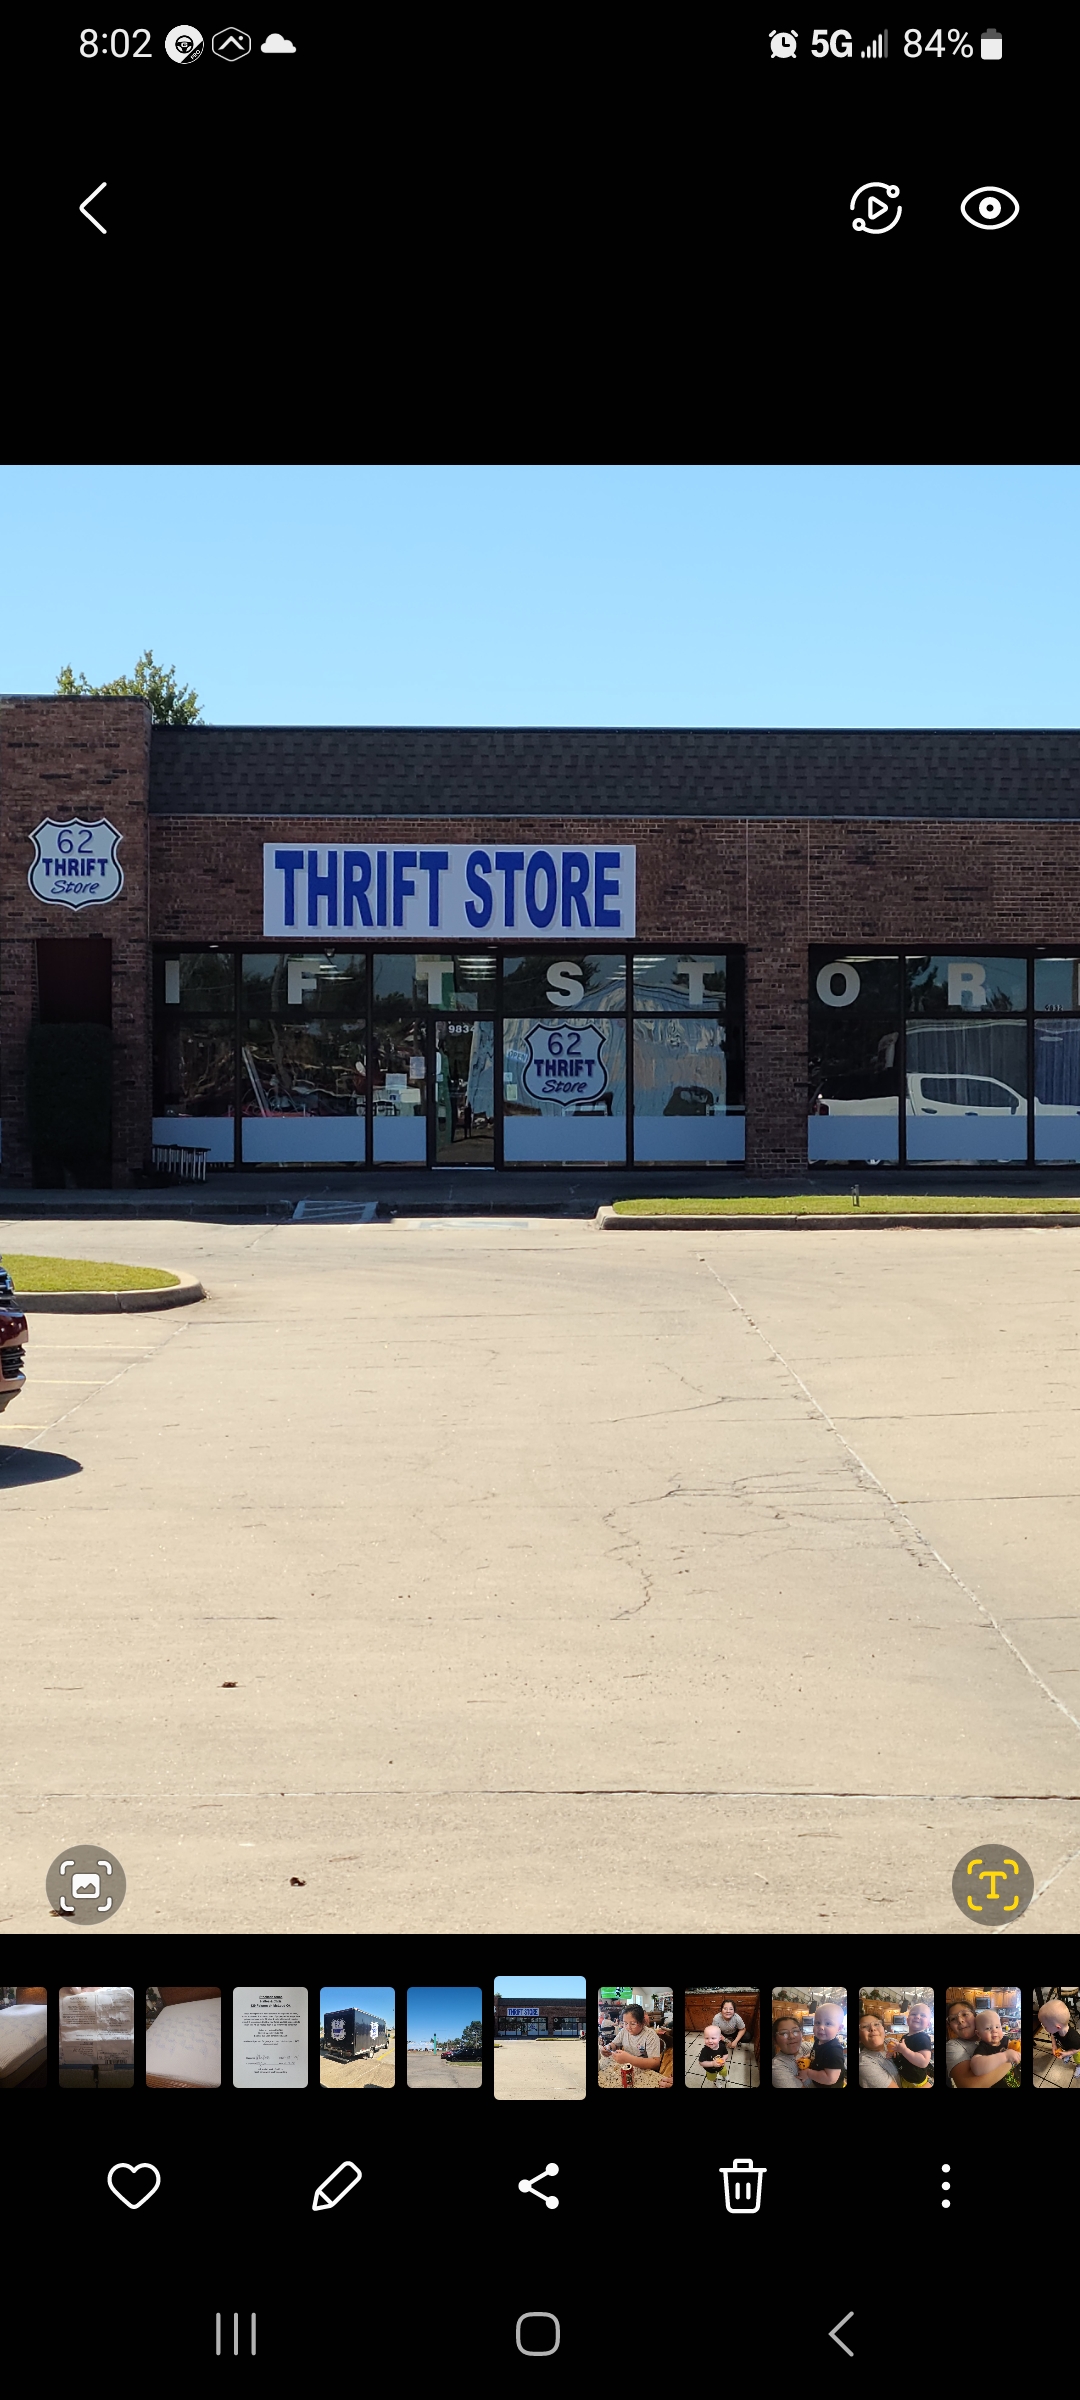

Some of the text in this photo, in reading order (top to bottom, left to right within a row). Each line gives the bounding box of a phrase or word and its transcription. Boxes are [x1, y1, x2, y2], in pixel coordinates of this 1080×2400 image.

[57, 829, 93, 854] 62
[42, 858, 108, 876] THRIFT
[50, 880, 100, 894] Store
[274, 850, 621, 928] THRIFT STORE
[548, 1032, 582, 1056] 62
[533, 1059, 595, 1077] THRIFT
[542, 1079, 587, 1093] Store
